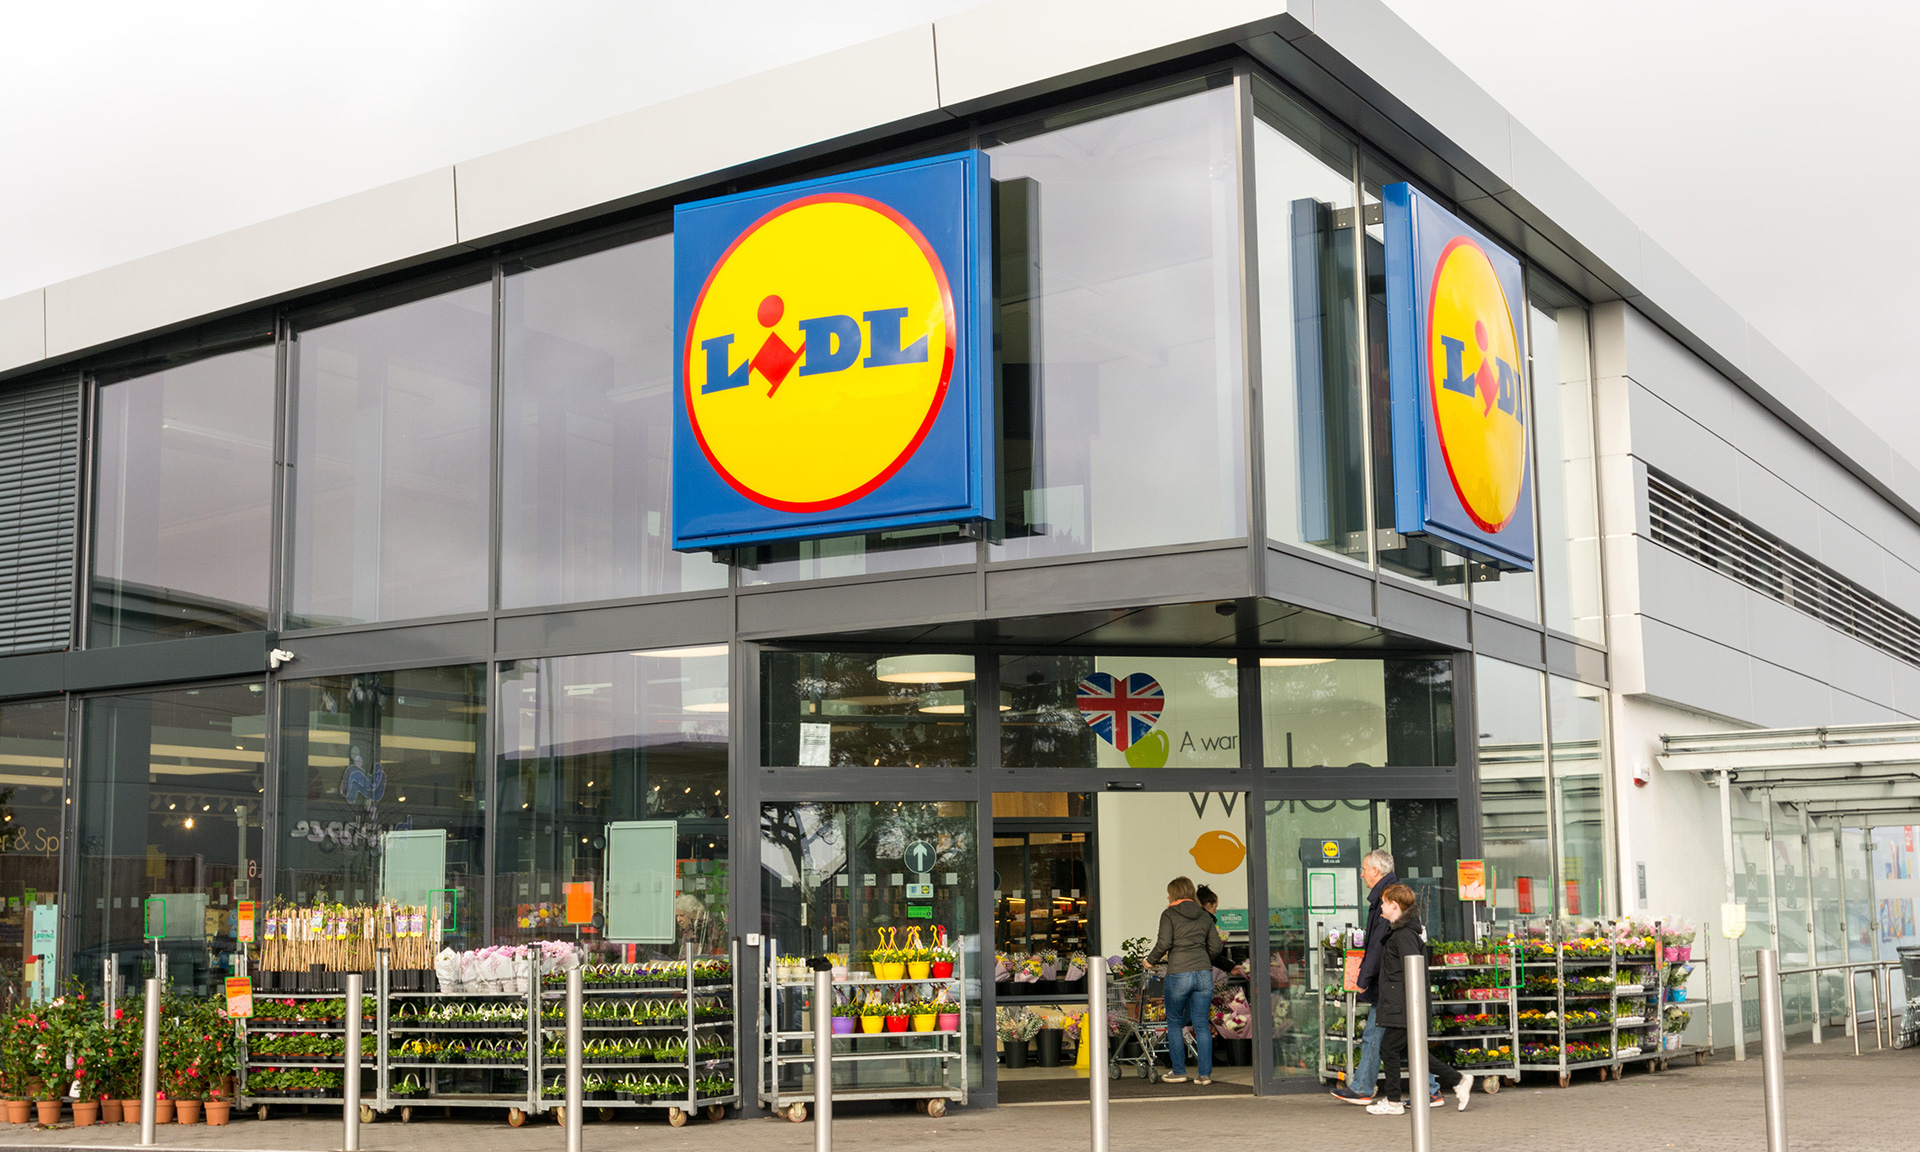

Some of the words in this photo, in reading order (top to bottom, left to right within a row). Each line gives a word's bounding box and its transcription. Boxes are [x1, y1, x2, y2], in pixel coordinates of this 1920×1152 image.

[1180, 731, 1196, 752] A
[1201, 735, 1238, 751] war
[14, 826, 30, 851] &
